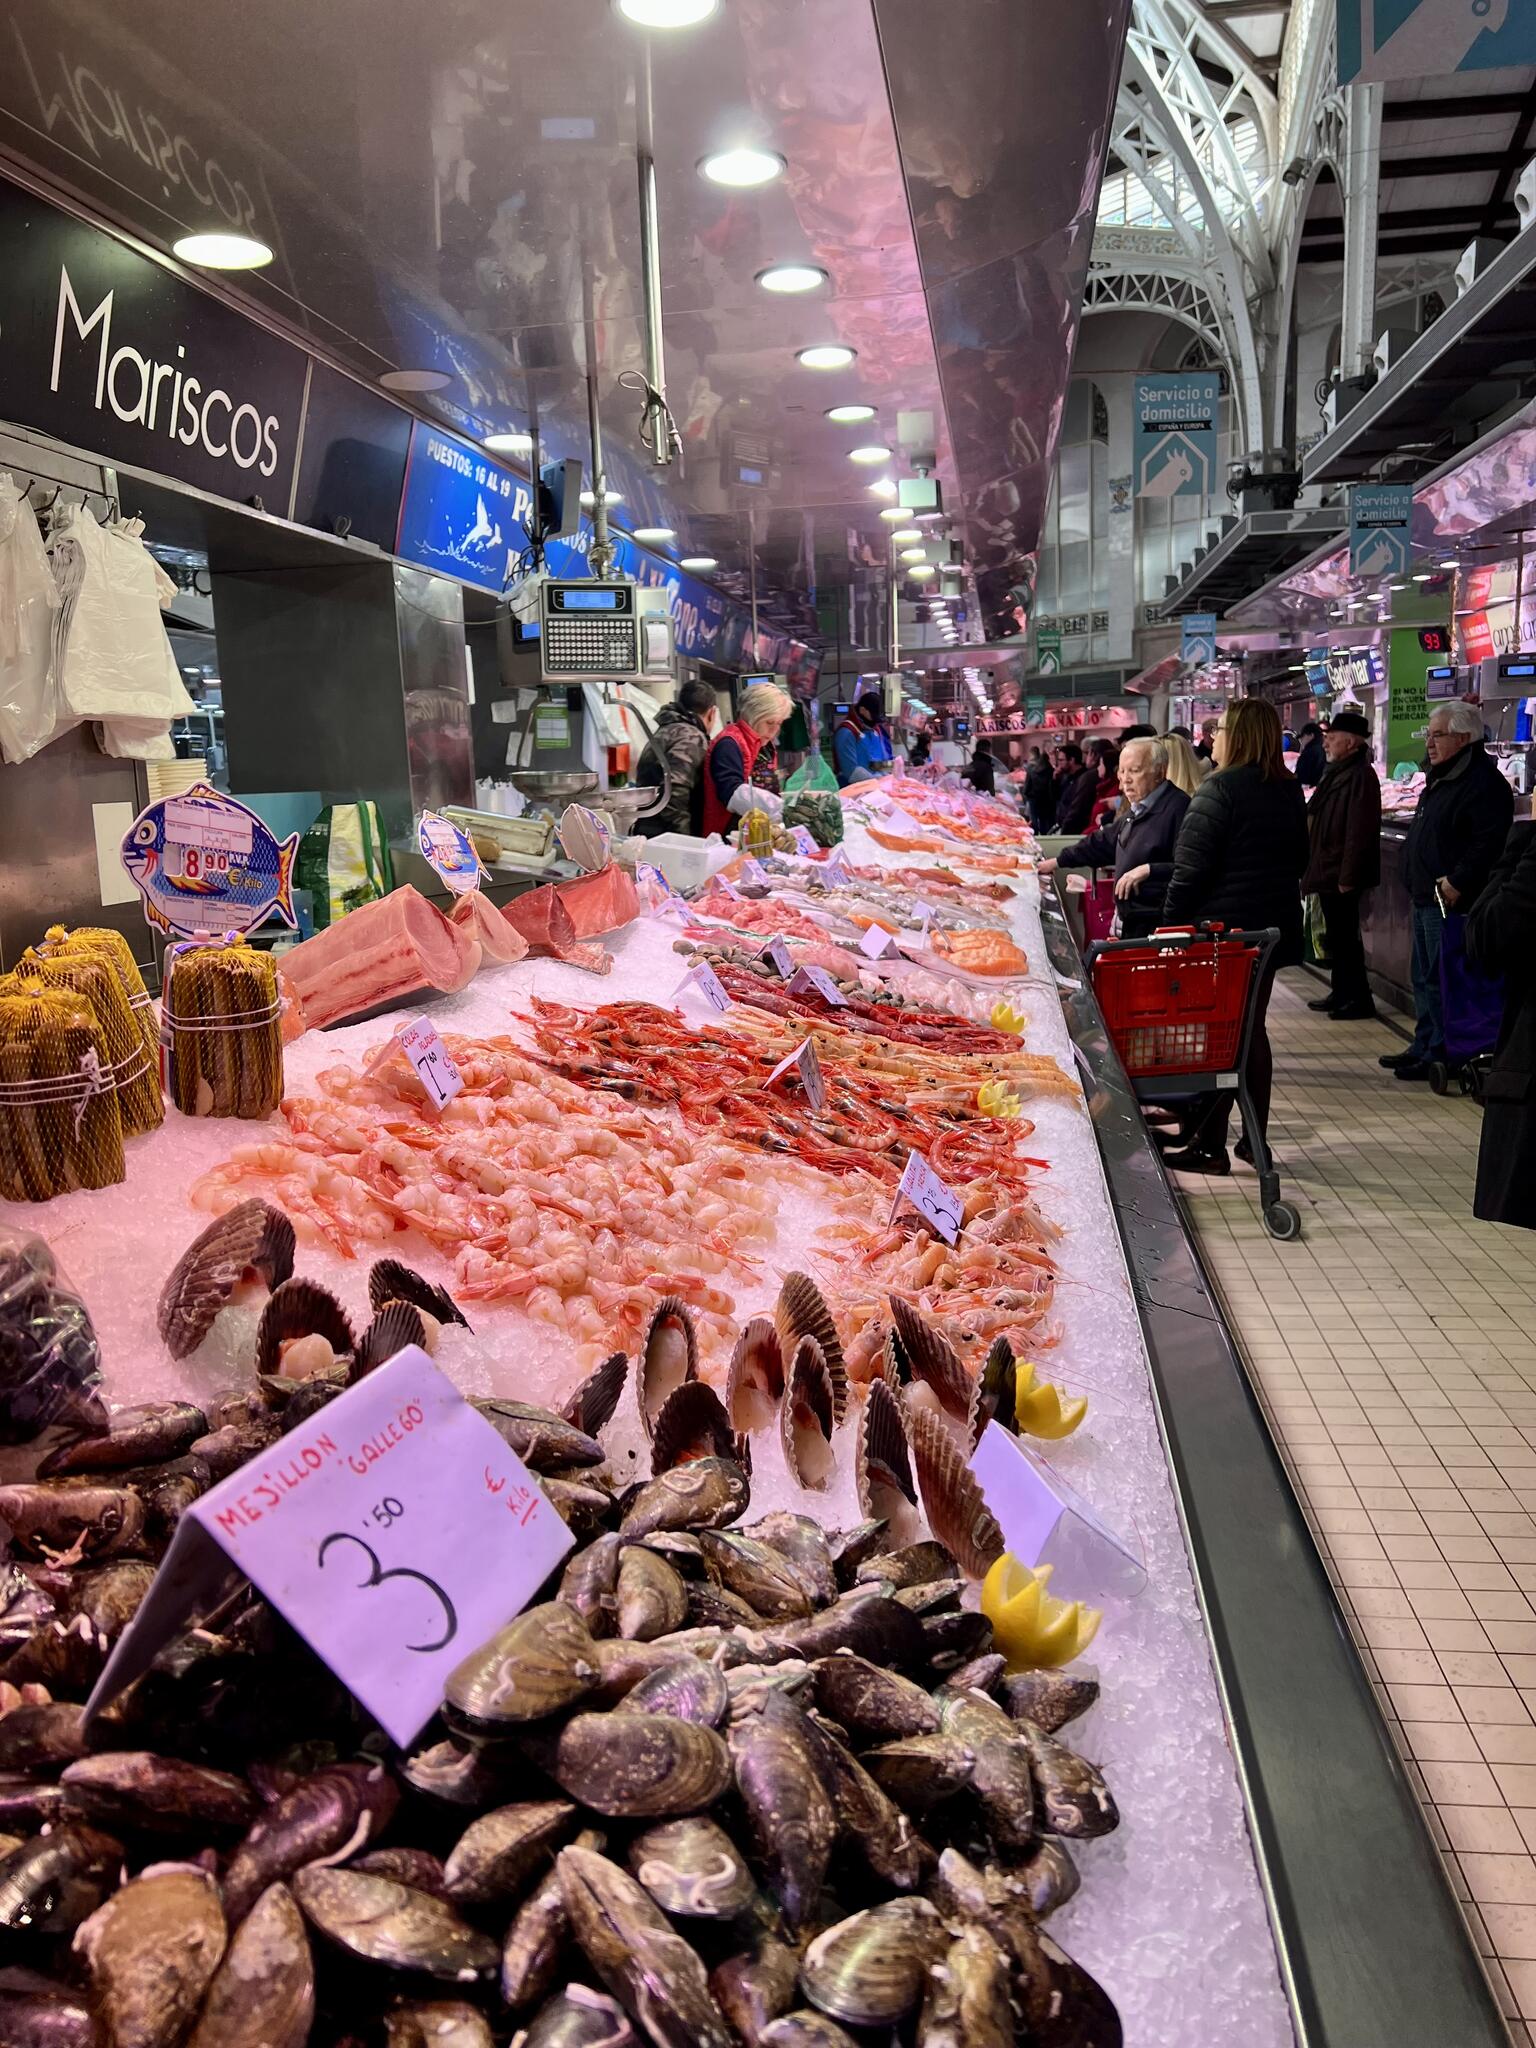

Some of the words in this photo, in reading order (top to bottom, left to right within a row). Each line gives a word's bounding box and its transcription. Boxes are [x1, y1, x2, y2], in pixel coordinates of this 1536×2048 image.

[50, 263, 280, 477] Mariscos
[1139, 384, 1200, 402] Servicio
[1204, 387, 1213, 399] a
[1141, 403, 1211, 421] domicilio
[427, 438, 473, 478] PUESTOS:
[475, 465, 486, 485] 16
[486, 471, 498, 492] AL
[500, 478, 511, 498] 19
[1424, 634, 1441, 650] 93
